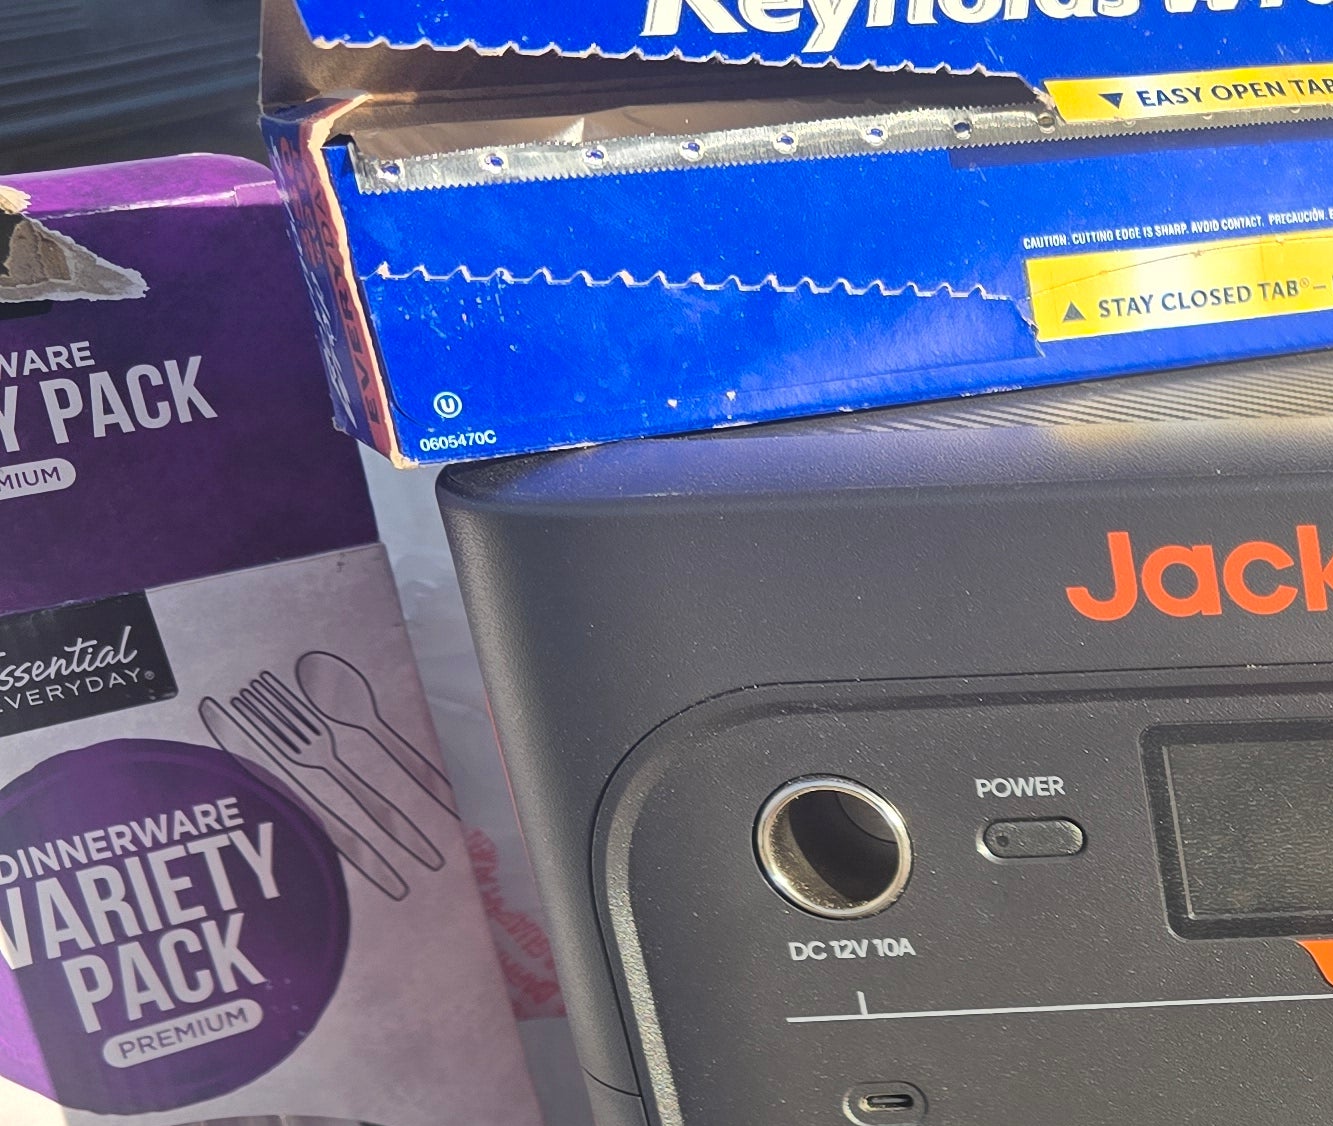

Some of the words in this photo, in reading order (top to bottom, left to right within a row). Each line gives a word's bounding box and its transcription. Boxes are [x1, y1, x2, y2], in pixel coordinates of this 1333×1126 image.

[1136, 86, 1203, 107] EASY
[1211, 80, 1288, 101] OPEN
[1023, 234, 1070, 250] CAUTION:
[1071, 228, 1114, 245] CUTTING
[1115, 226, 1141, 241] EDGE
[1143, 225, 1154, 239] IS
[1155, 222, 1189, 238] SHARP.
[1191, 219, 1219, 234] AVOID
[1221, 215, 1265, 232] CONTACT.
[1098, 294, 1154, 318] STAY
[1161, 284, 1252, 312] CLOSED
[39, 355, 219, 445] PACK
[419, 429, 497, 452] 0605470C
[0, 625, 138, 691] ssential
[0, 668, 140, 713] VERYDAY
[975, 774, 1066, 799] POWER
[0, 821, 281, 971] VARIETY
[788, 941, 828, 961] DC
[831, 939, 869, 960] 12V
[873, 936, 916, 958] 10A
[61, 912, 268, 1034] PACK
[118, 1007, 249, 1060] PREMIUM
